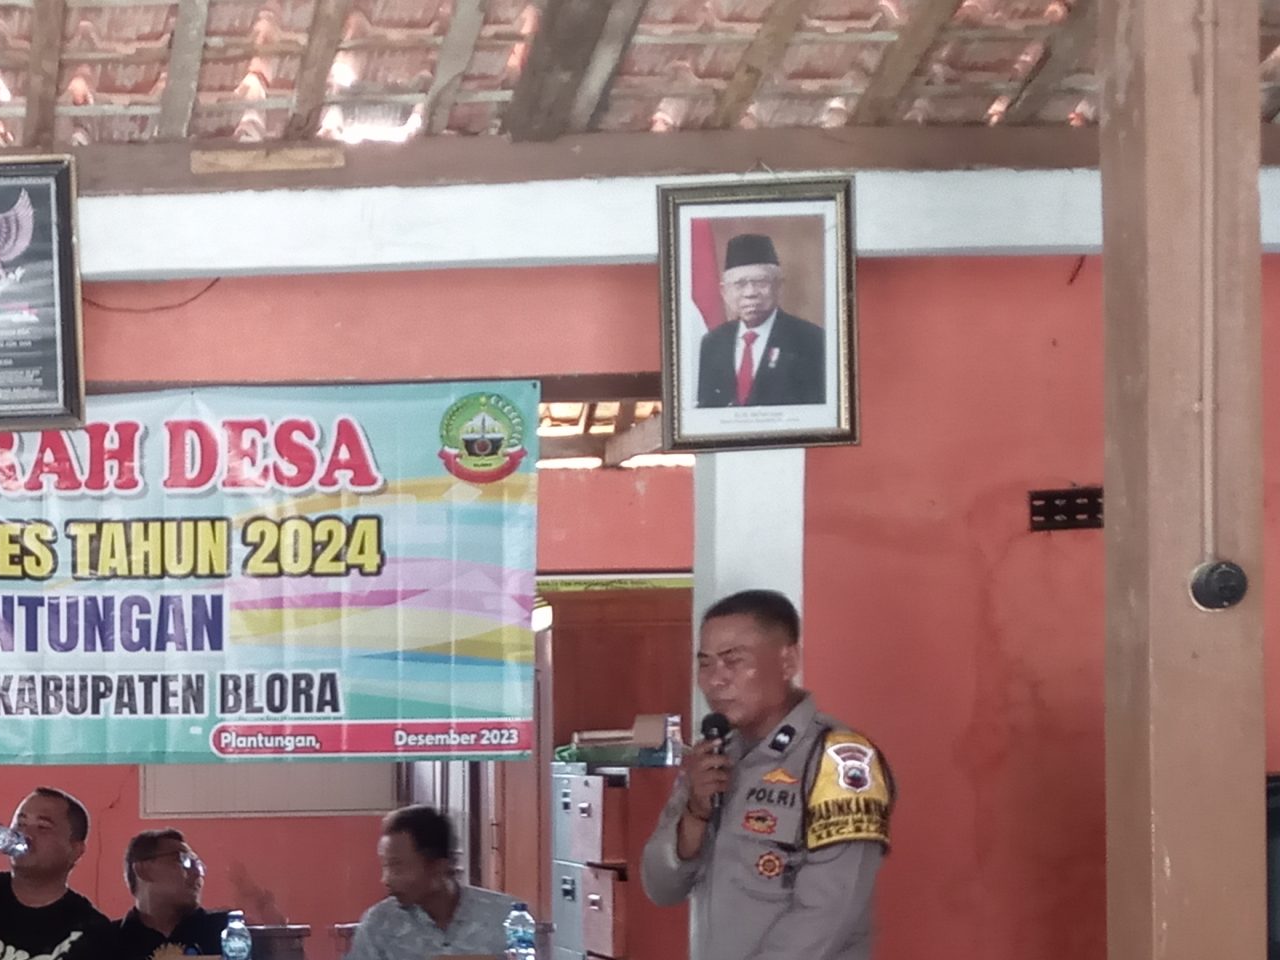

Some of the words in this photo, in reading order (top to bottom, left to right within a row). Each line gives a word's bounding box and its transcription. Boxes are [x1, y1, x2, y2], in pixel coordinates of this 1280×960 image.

[164, 419, 380, 489] DESA
[69, 517, 232, 577] TAHUN
[244, 516, 384, 577] 2024
[221, 672, 340, 713] BLORA
[220, 732, 321, 750] Plantungan,
[395, 730, 475, 746] Desember
[480, 729, 519, 745] 2023
[746, 787, 796, 807] POLRI
